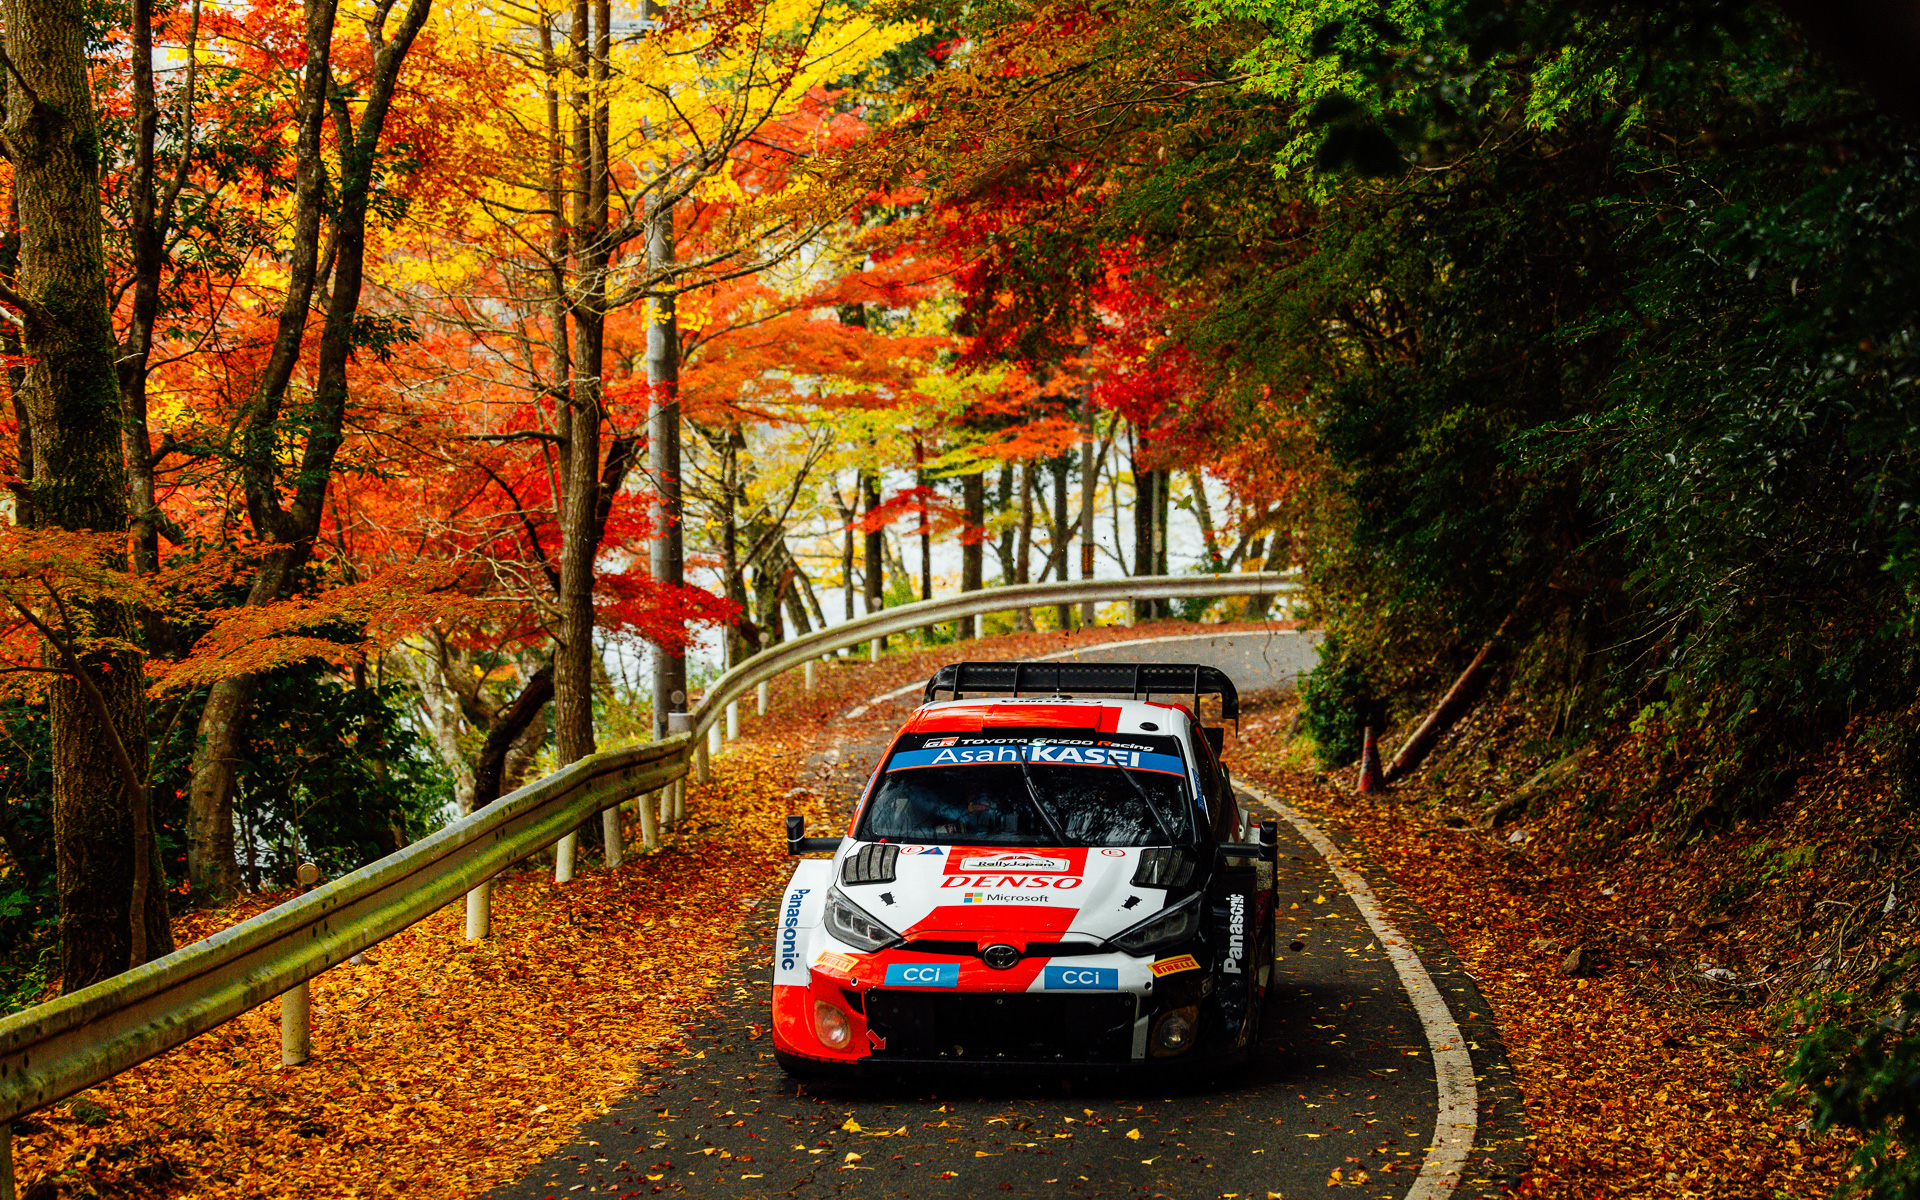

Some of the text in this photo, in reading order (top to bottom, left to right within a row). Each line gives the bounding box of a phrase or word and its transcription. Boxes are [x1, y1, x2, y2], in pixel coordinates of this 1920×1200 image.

[926, 739, 956, 748] GR
[1097, 740, 1154, 752] Racing
[931, 746, 1140, 767] Asahi KASEI
[940, 876, 1083, 889] DENSO
[986, 893, 1049, 903] Microsoft
[781, 889, 811, 971] Panasonic
[1223, 893, 1245, 974] Panasonic
[818, 951, 854, 969] PIRELLI
[1152, 957, 1196, 974] PIRELLI
